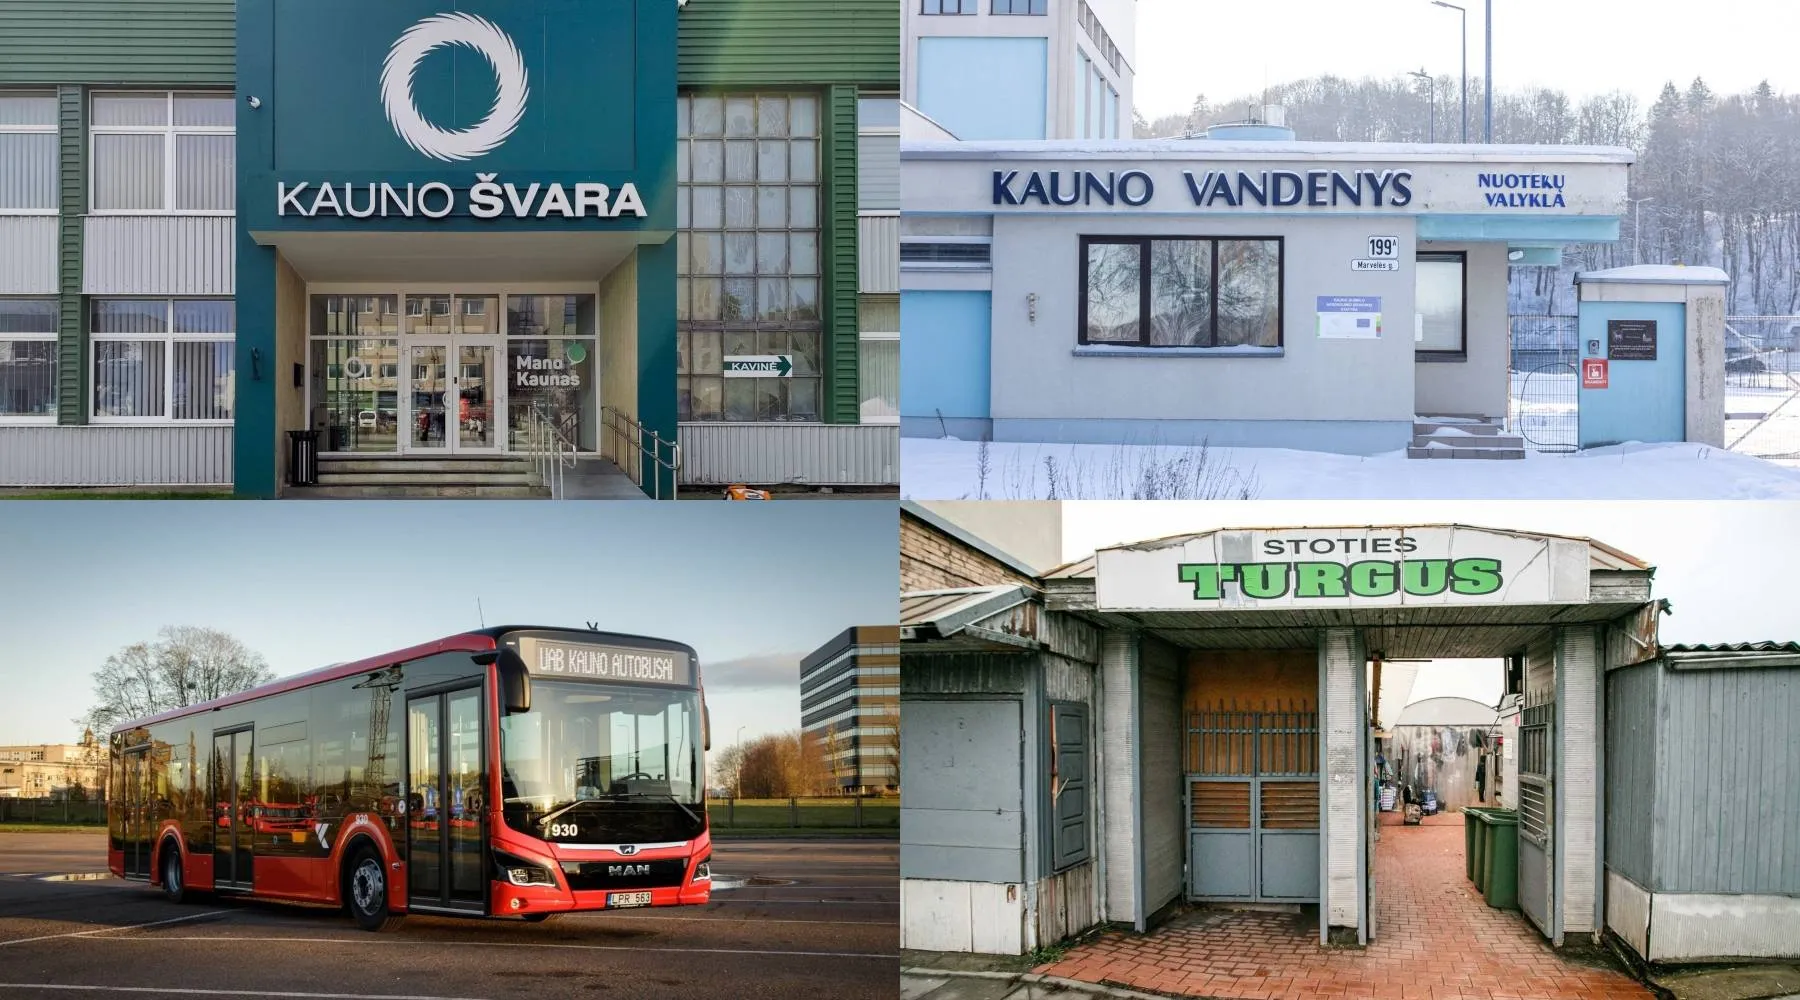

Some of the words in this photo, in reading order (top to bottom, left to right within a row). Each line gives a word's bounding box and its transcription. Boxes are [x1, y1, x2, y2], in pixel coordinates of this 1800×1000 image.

[992, 170, 1154, 207] KAUNO
[1182, 169, 1413, 208] VANDENYS
[1478, 173, 1565, 192] NUOTEKŲ
[277, 181, 455, 218] KAUNO
[468, 172, 648, 218] ŠVARA
[1484, 193, 1566, 208] VALYKLA
[516, 355, 563, 370] Mano
[731, 361, 778, 371] KAVINĖ
[516, 371, 580, 387] Kaunas
[1263, 537, 1418, 555] STOTIES
[1177, 558, 1504, 600] TURGUS
[539, 647, 564, 672] UAB
[568, 649, 608, 676] KAUNO
[611, 653, 673, 681] AUTOBUSAI
[355, 814, 369, 825] 930
[551, 824, 578, 837] 930
[608, 864, 650, 876] MAN
[612, 894, 630, 905] LPR
